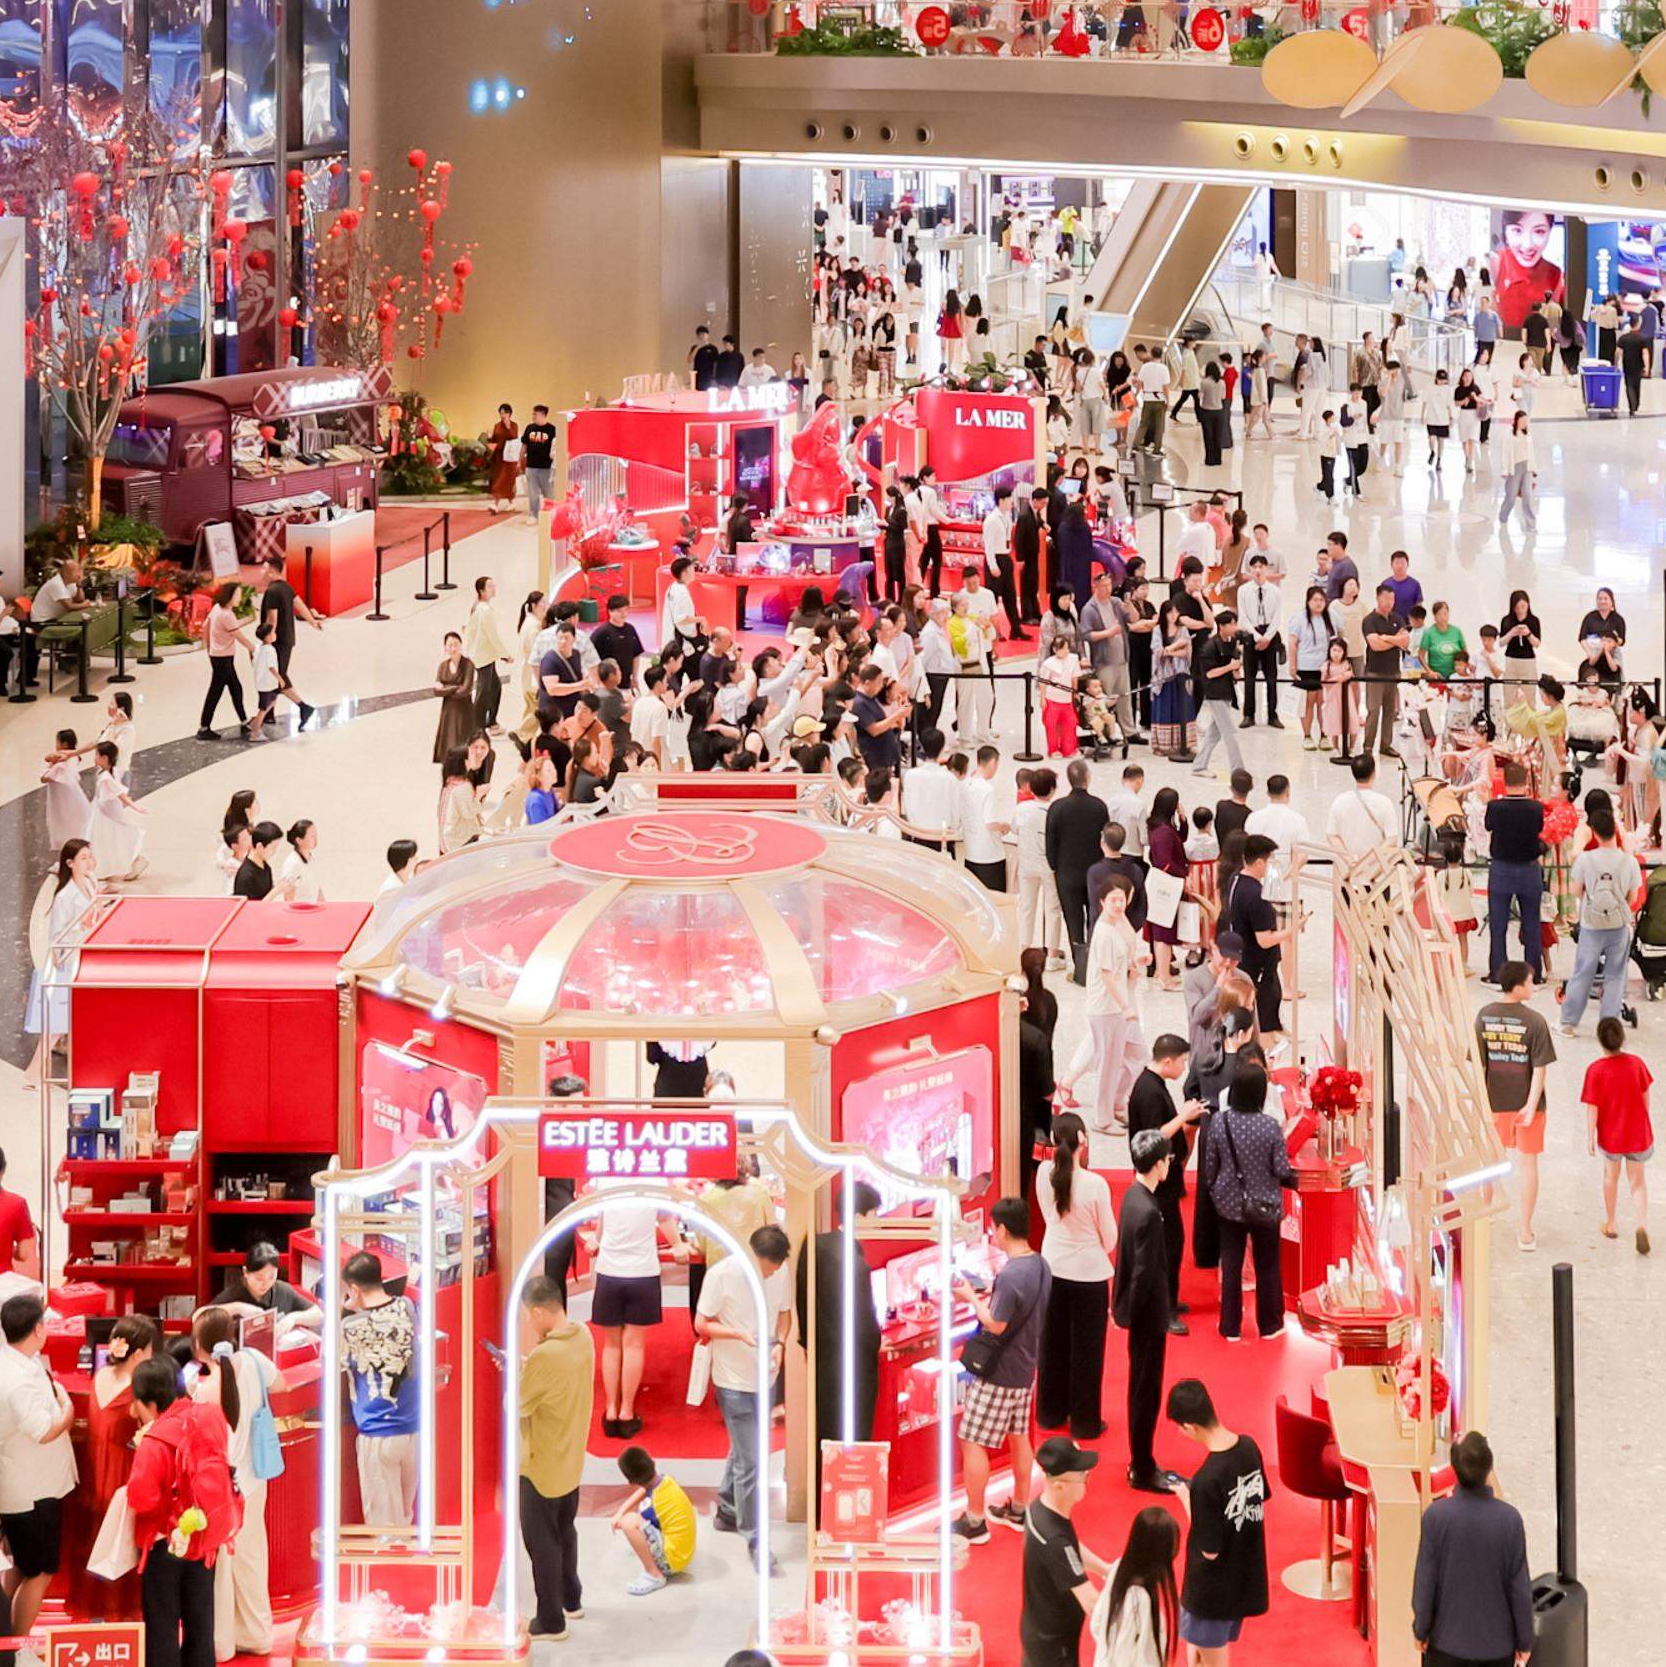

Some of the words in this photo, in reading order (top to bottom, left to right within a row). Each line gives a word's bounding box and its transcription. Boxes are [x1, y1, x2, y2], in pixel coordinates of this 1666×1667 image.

[290, 377, 362, 407] BURBERRY
[707, 387, 744, 413] LA
[955, 408, 981, 427] LA
[986, 409, 1026, 430] MER
[625, 1122, 728, 1147] LAUDER
[94, 1642, 131, 1661] 出口
